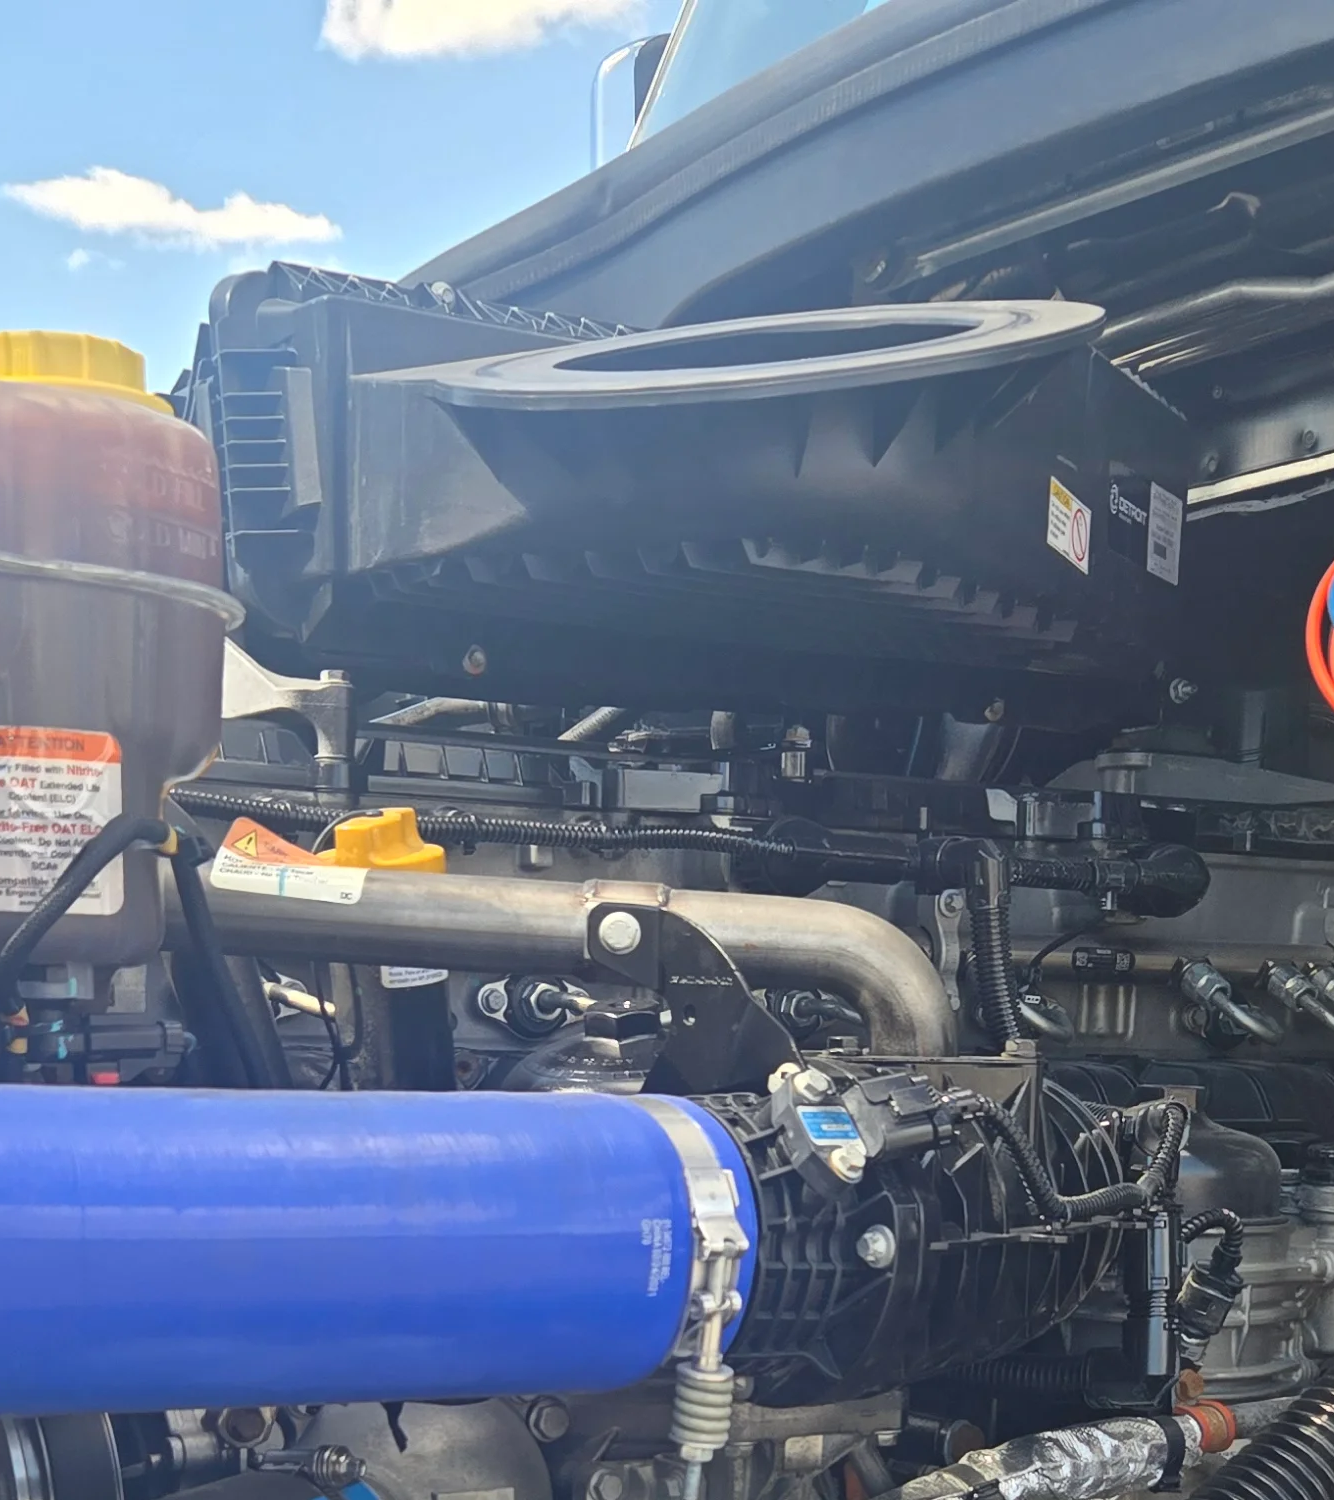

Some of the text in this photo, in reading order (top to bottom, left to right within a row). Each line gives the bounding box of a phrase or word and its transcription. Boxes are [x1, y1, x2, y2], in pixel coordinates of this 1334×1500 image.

[1118, 496, 1147, 527] DETROIT
[51, 823, 77, 835] OAT
[340, 892, 353, 900] DC
